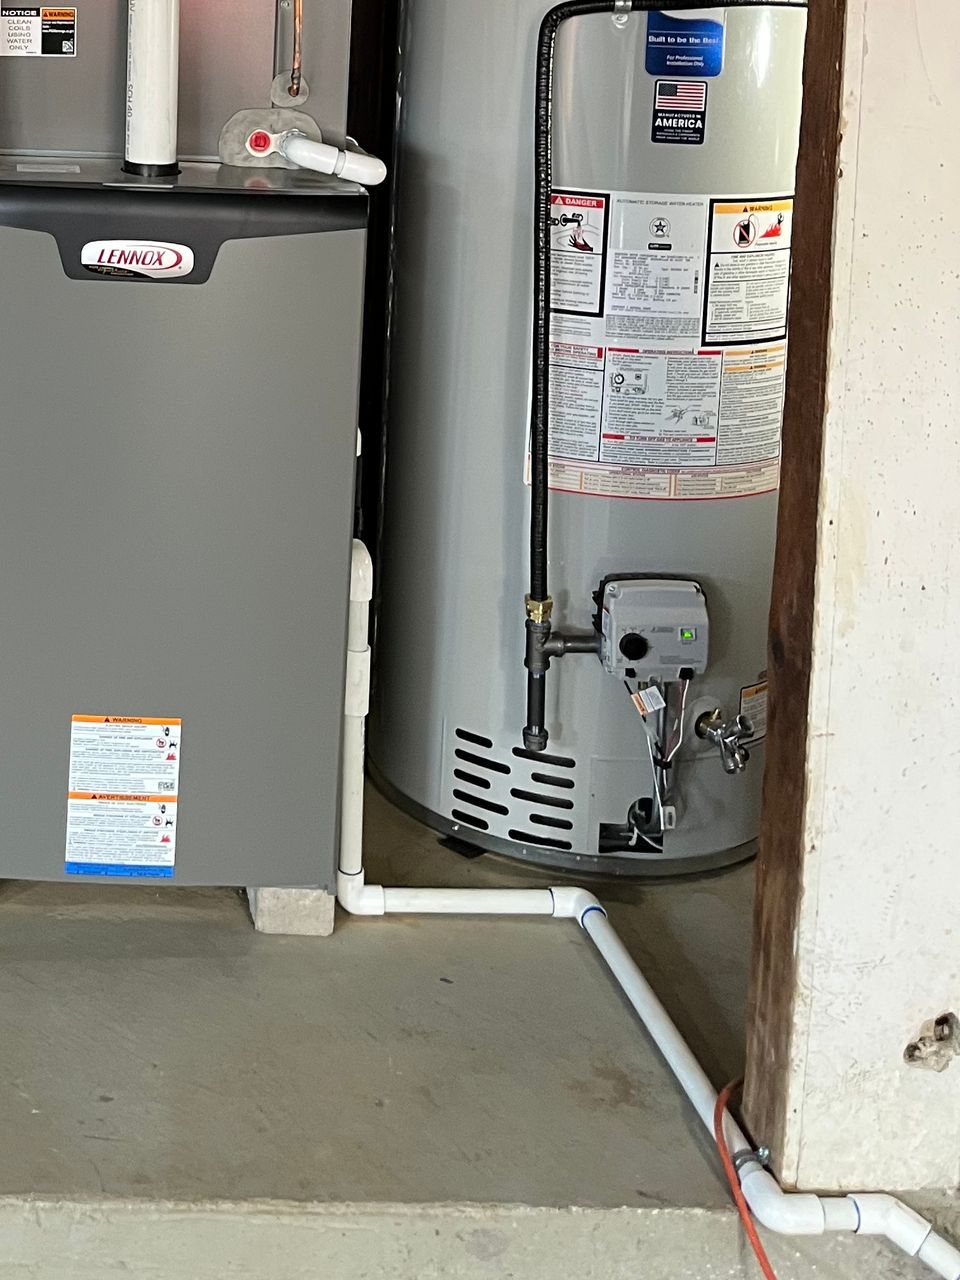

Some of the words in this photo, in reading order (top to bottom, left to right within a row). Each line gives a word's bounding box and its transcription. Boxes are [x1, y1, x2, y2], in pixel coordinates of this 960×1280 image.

[648, 35, 665, 43] Built
[654, 117, 703, 128] AMERICA
[565, 197, 598, 207] DANGER
[97, 249, 167, 266] LENNOX
